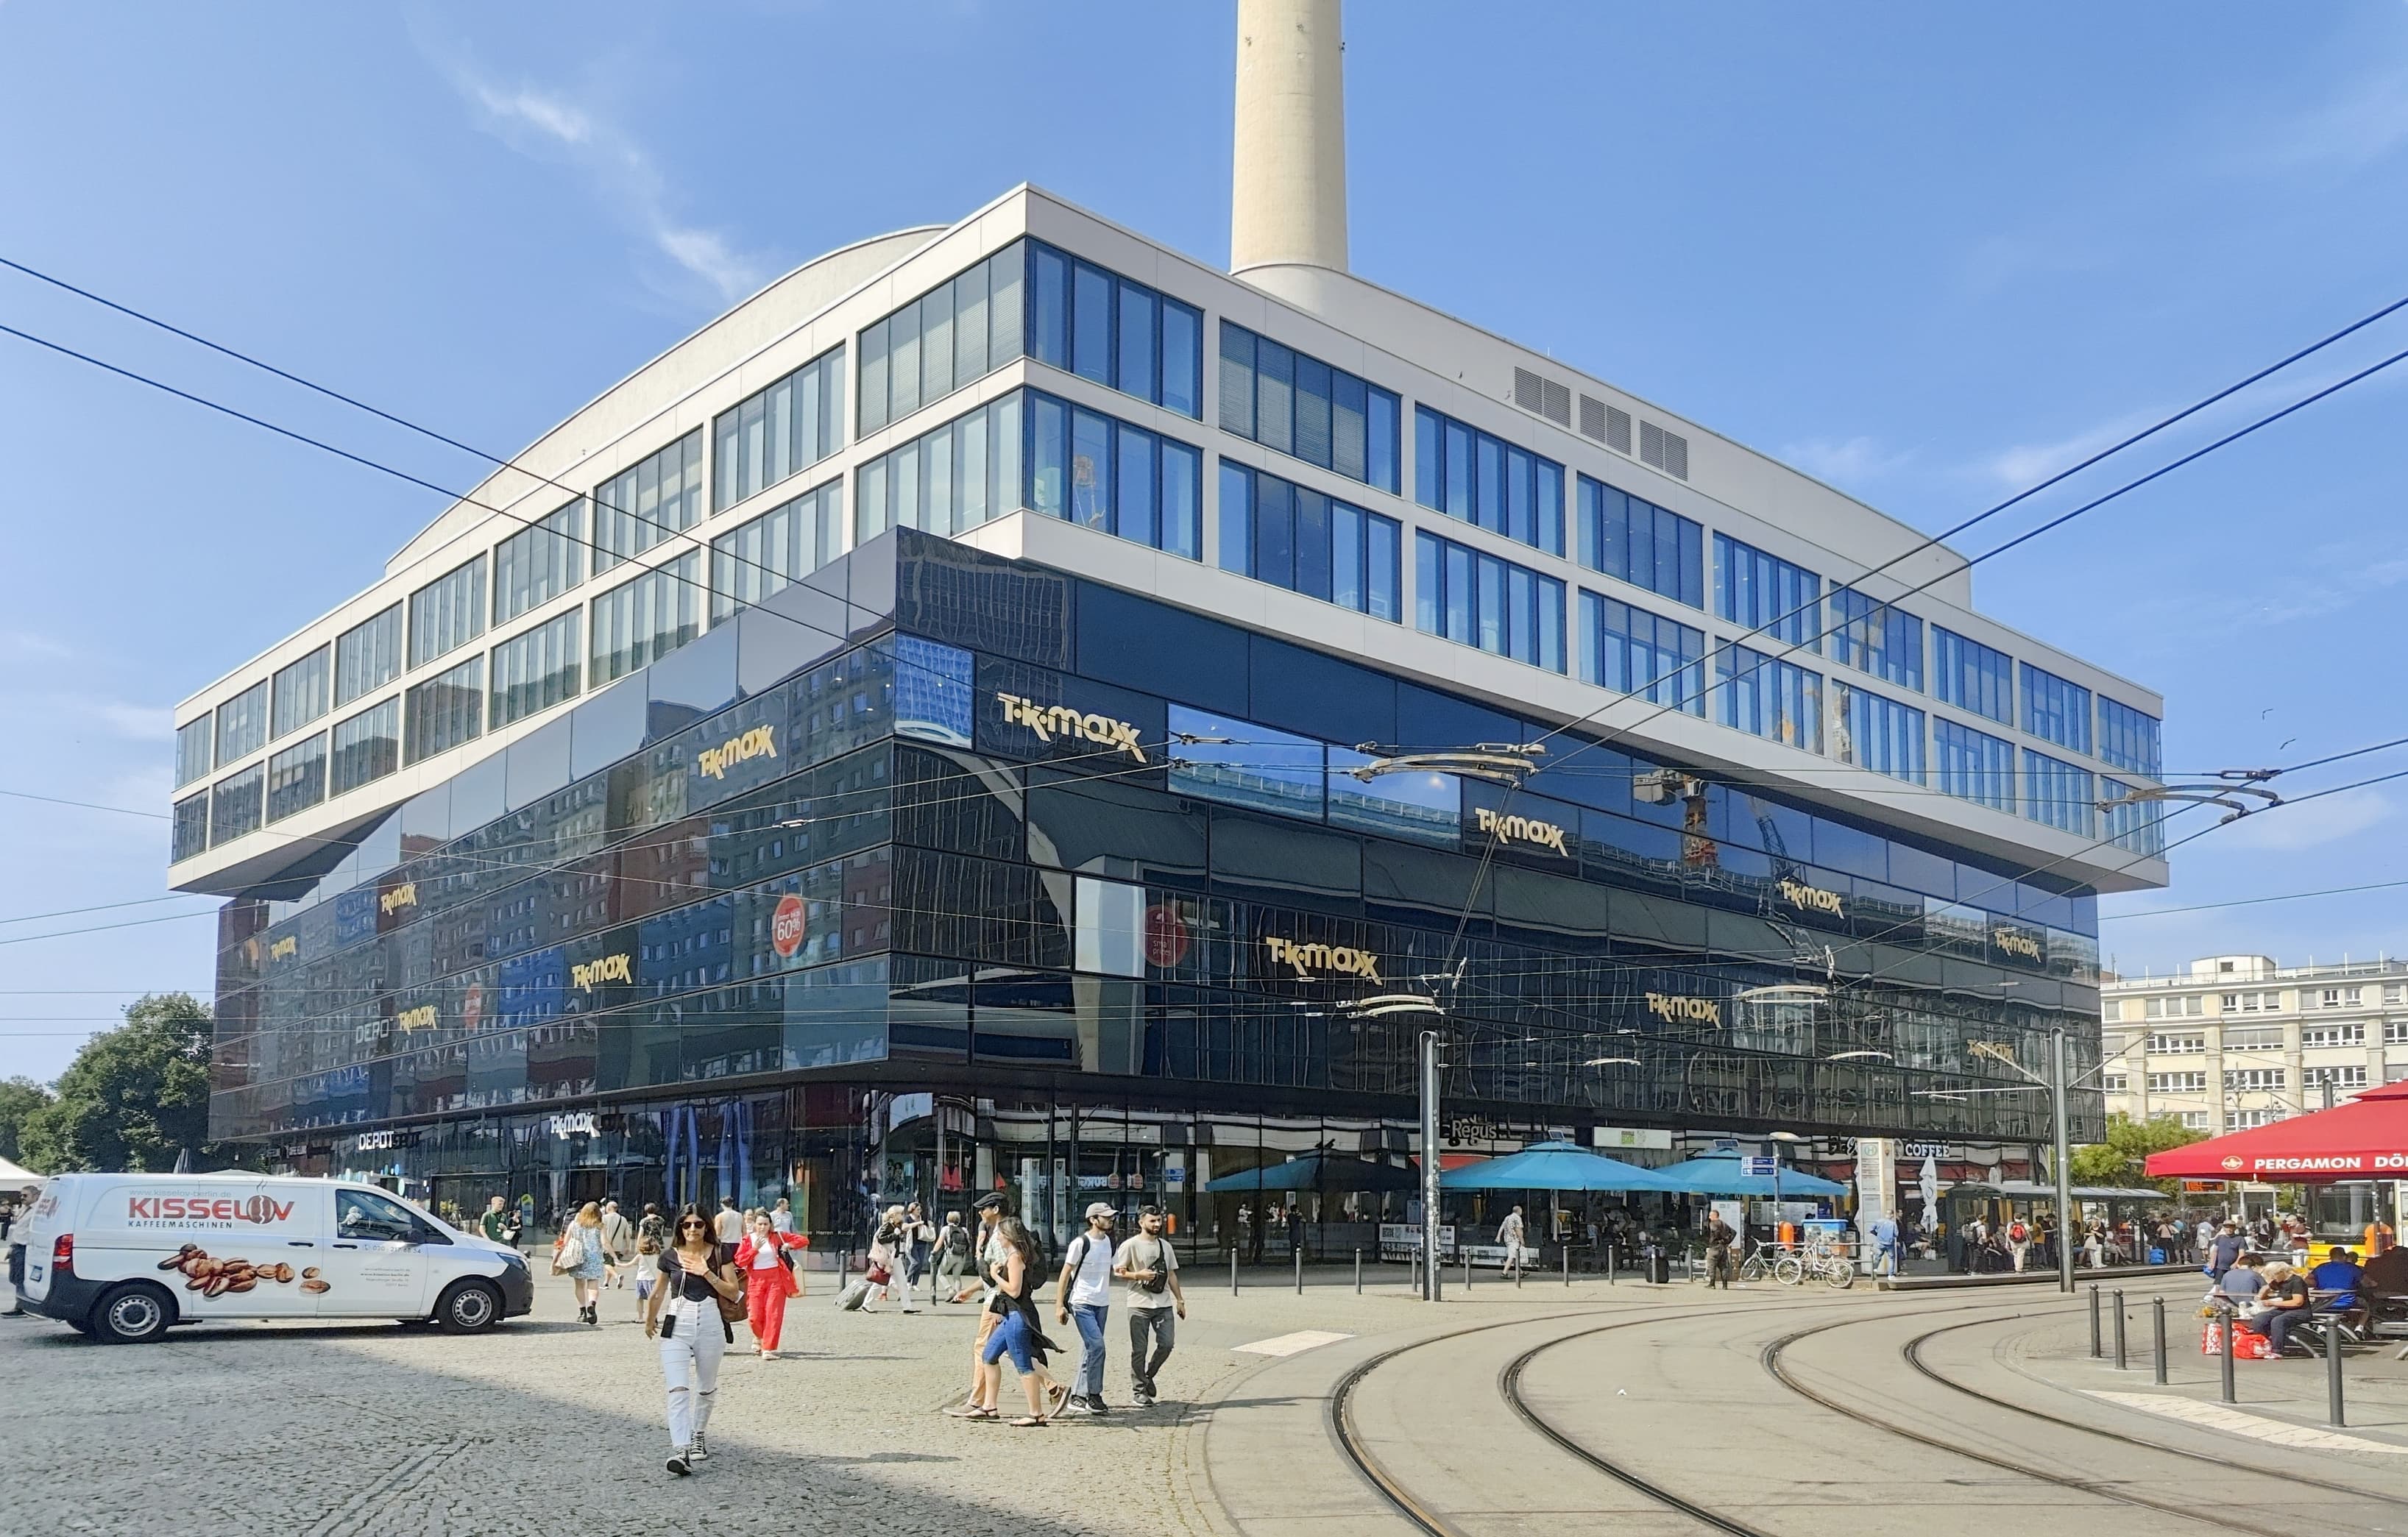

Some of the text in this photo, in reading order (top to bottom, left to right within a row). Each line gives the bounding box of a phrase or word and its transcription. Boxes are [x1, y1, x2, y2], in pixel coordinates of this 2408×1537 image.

[777, 917, 801, 942] 60%
[358, 1131, 394, 1151] DEPOT
[1451, 1120, 1498, 1146] Regus
[1905, 1143, 1950, 1158] COFFEE
[2254, 1157, 2361, 1170] PERGAMON
[129, 1194, 295, 1225] KISSELOV
[128, 1219, 233, 1229] KAFFEEMASCHINEN
